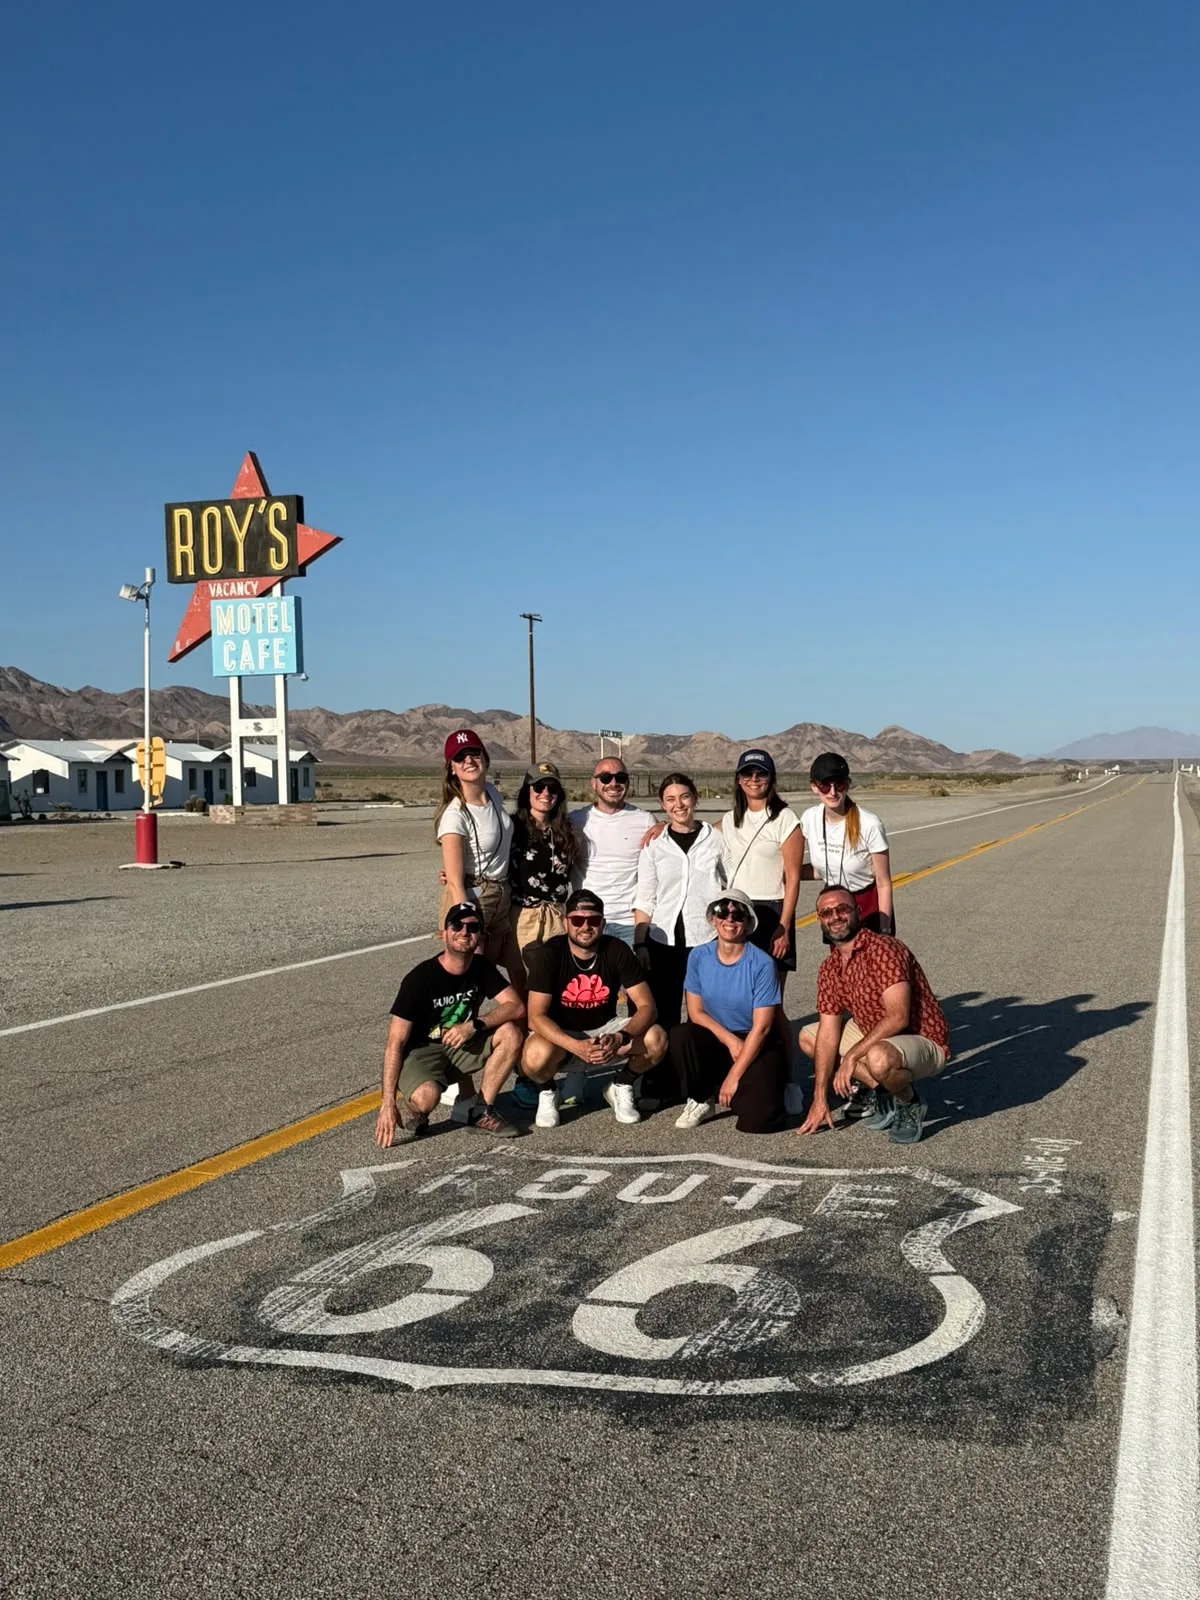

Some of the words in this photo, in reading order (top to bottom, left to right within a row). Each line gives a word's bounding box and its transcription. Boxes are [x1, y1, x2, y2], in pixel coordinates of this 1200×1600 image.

[172, 499, 289, 576] ROY'S
[208, 580, 260, 598] VACANCY
[215, 601, 292, 636] MOTEL
[223, 637, 287, 672] CAFE
[456, 732, 469, 744] NY
[256, 1203, 804, 1361] 66
